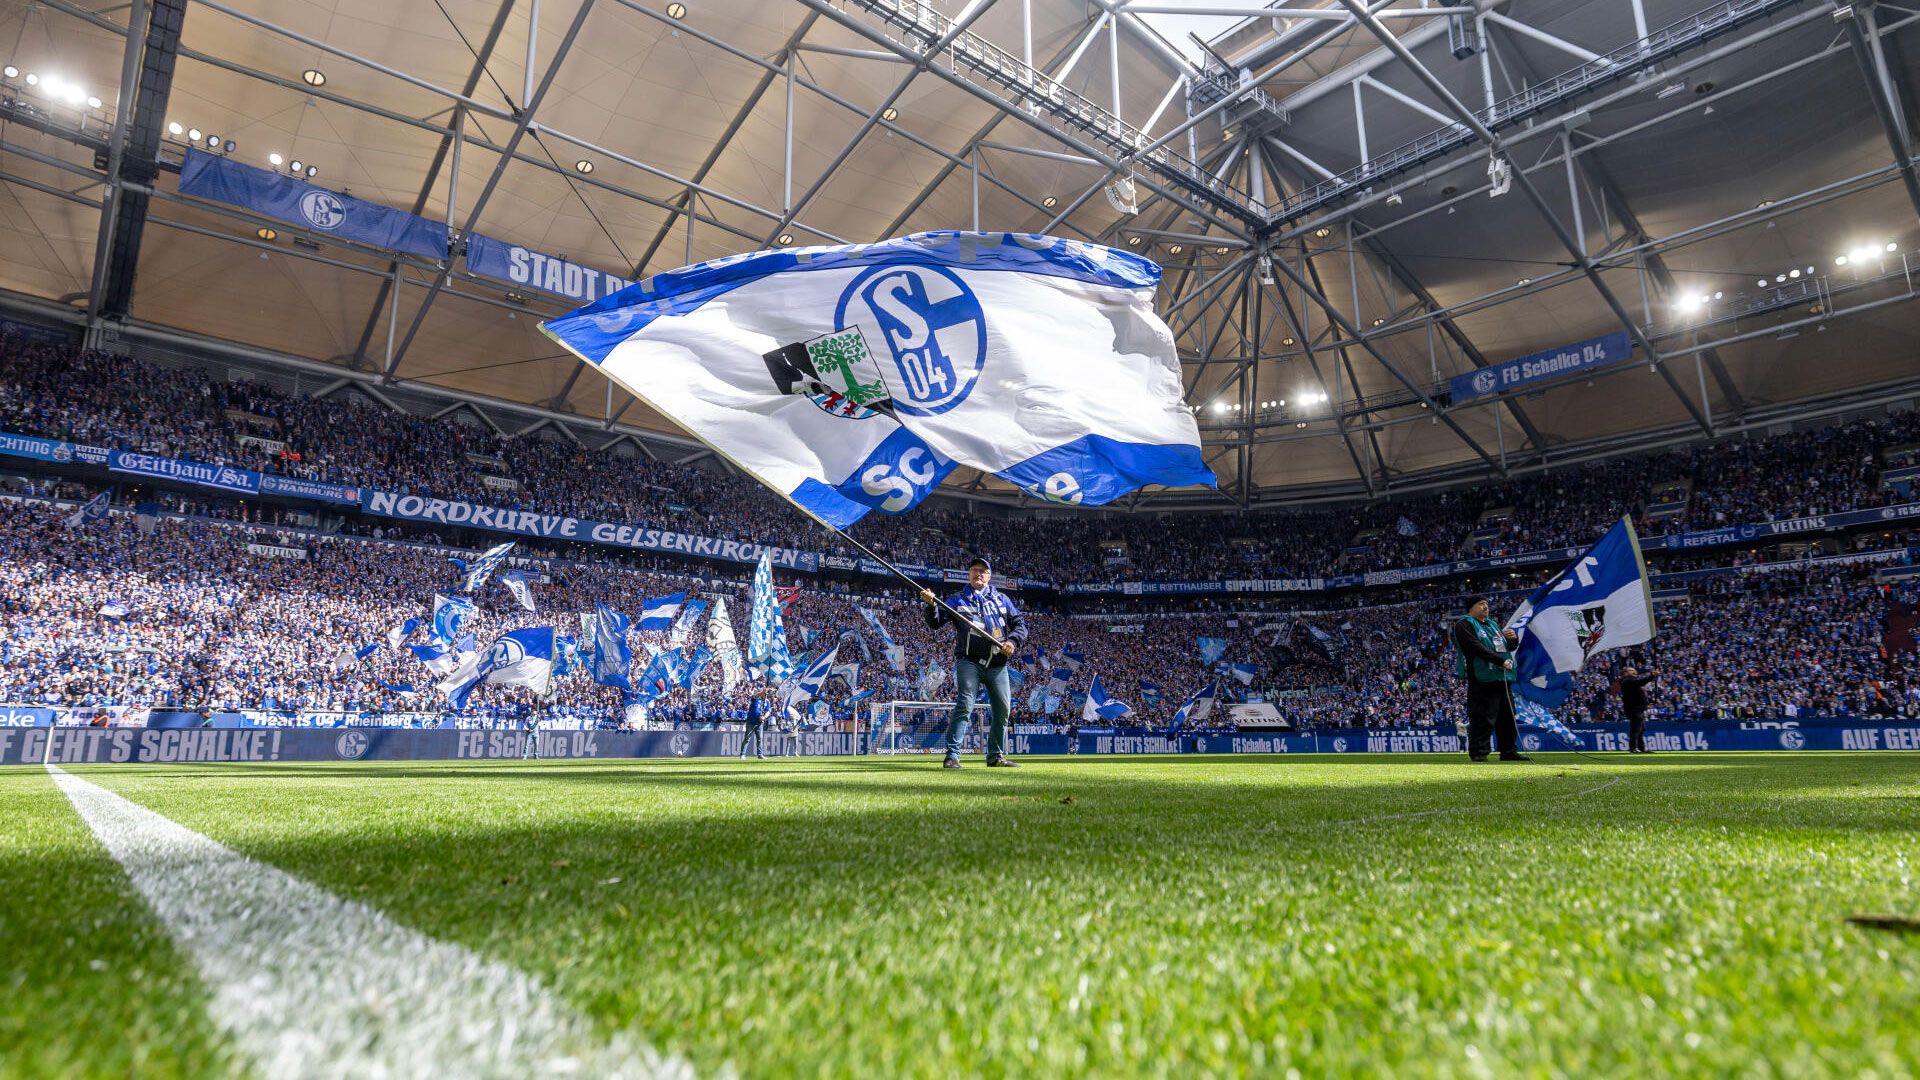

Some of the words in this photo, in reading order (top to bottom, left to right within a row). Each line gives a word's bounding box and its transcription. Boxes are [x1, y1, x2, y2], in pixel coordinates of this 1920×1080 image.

[510, 246, 600, 301] STADT
[873, 273, 931, 353] S
[1502, 368, 1520, 384] FC
[1524, 352, 1581, 379] Schalke
[1583, 343, 1606, 363] 04
[902, 347, 948, 401] 04
[76, 452, 107, 463] POWER
[277, 483, 344, 500] HAMBURG
[370, 491, 579, 538] NORDKURVE
[591, 522, 799, 568] GELSENKIRCHEN
[1770, 516, 1827, 534] VELTINS
[260, 546, 300, 559] VELTINS
[1142, 583, 1158, 592] DIE
[1225, 580, 1289, 592] SUPPORTERS
[1297, 578, 1324, 591] CLUB
[344, 713, 412, 729] Rheinberg
[21, 728, 133, 764] GEHT'S
[138, 728, 267, 763] SCHALKE
[458, 731, 485, 759] FC
[571, 731, 598, 757] 04
[1016, 735, 1031, 754] 04
[1096, 736, 1113, 753] AUF
[1114, 736, 1142, 753] GEHT'S
[1232, 737, 1241, 753] FC
[1242, 737, 1272, 753] Schalke
[1273, 737, 1288, 753] 04
[1367, 737, 1388, 753] AUF
[1390, 737, 1430, 753] GEHT'S
[1596, 733, 1616, 751] FC
[1618, 731, 1681, 751] Salke
[1684, 731, 1709, 751] 04
[1841, 728, 1880, 750] AUF
